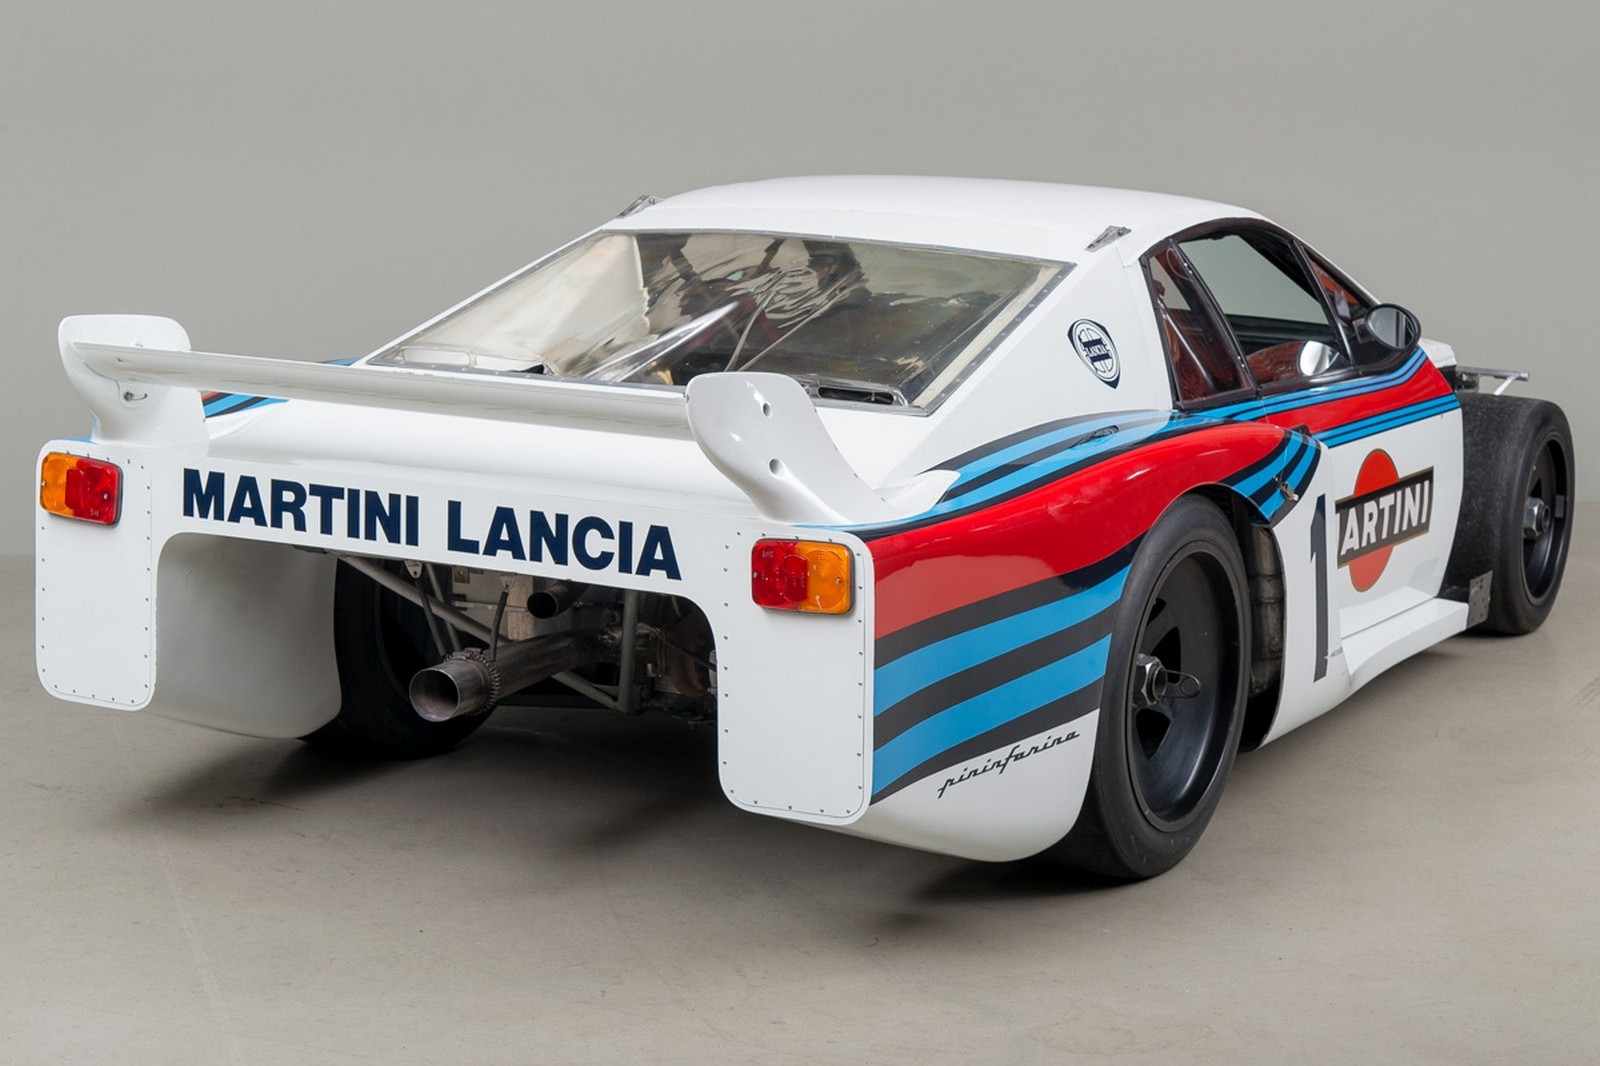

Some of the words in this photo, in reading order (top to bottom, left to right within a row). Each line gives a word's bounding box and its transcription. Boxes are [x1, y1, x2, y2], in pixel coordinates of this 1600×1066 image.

[183, 468, 419, 547] MARTINI
[448, 500, 682, 581] LANCIA
[1335, 480, 1430, 556] ARTINI
[1310, 493, 1329, 683] 1
[937, 731, 1080, 799] pininfarina
